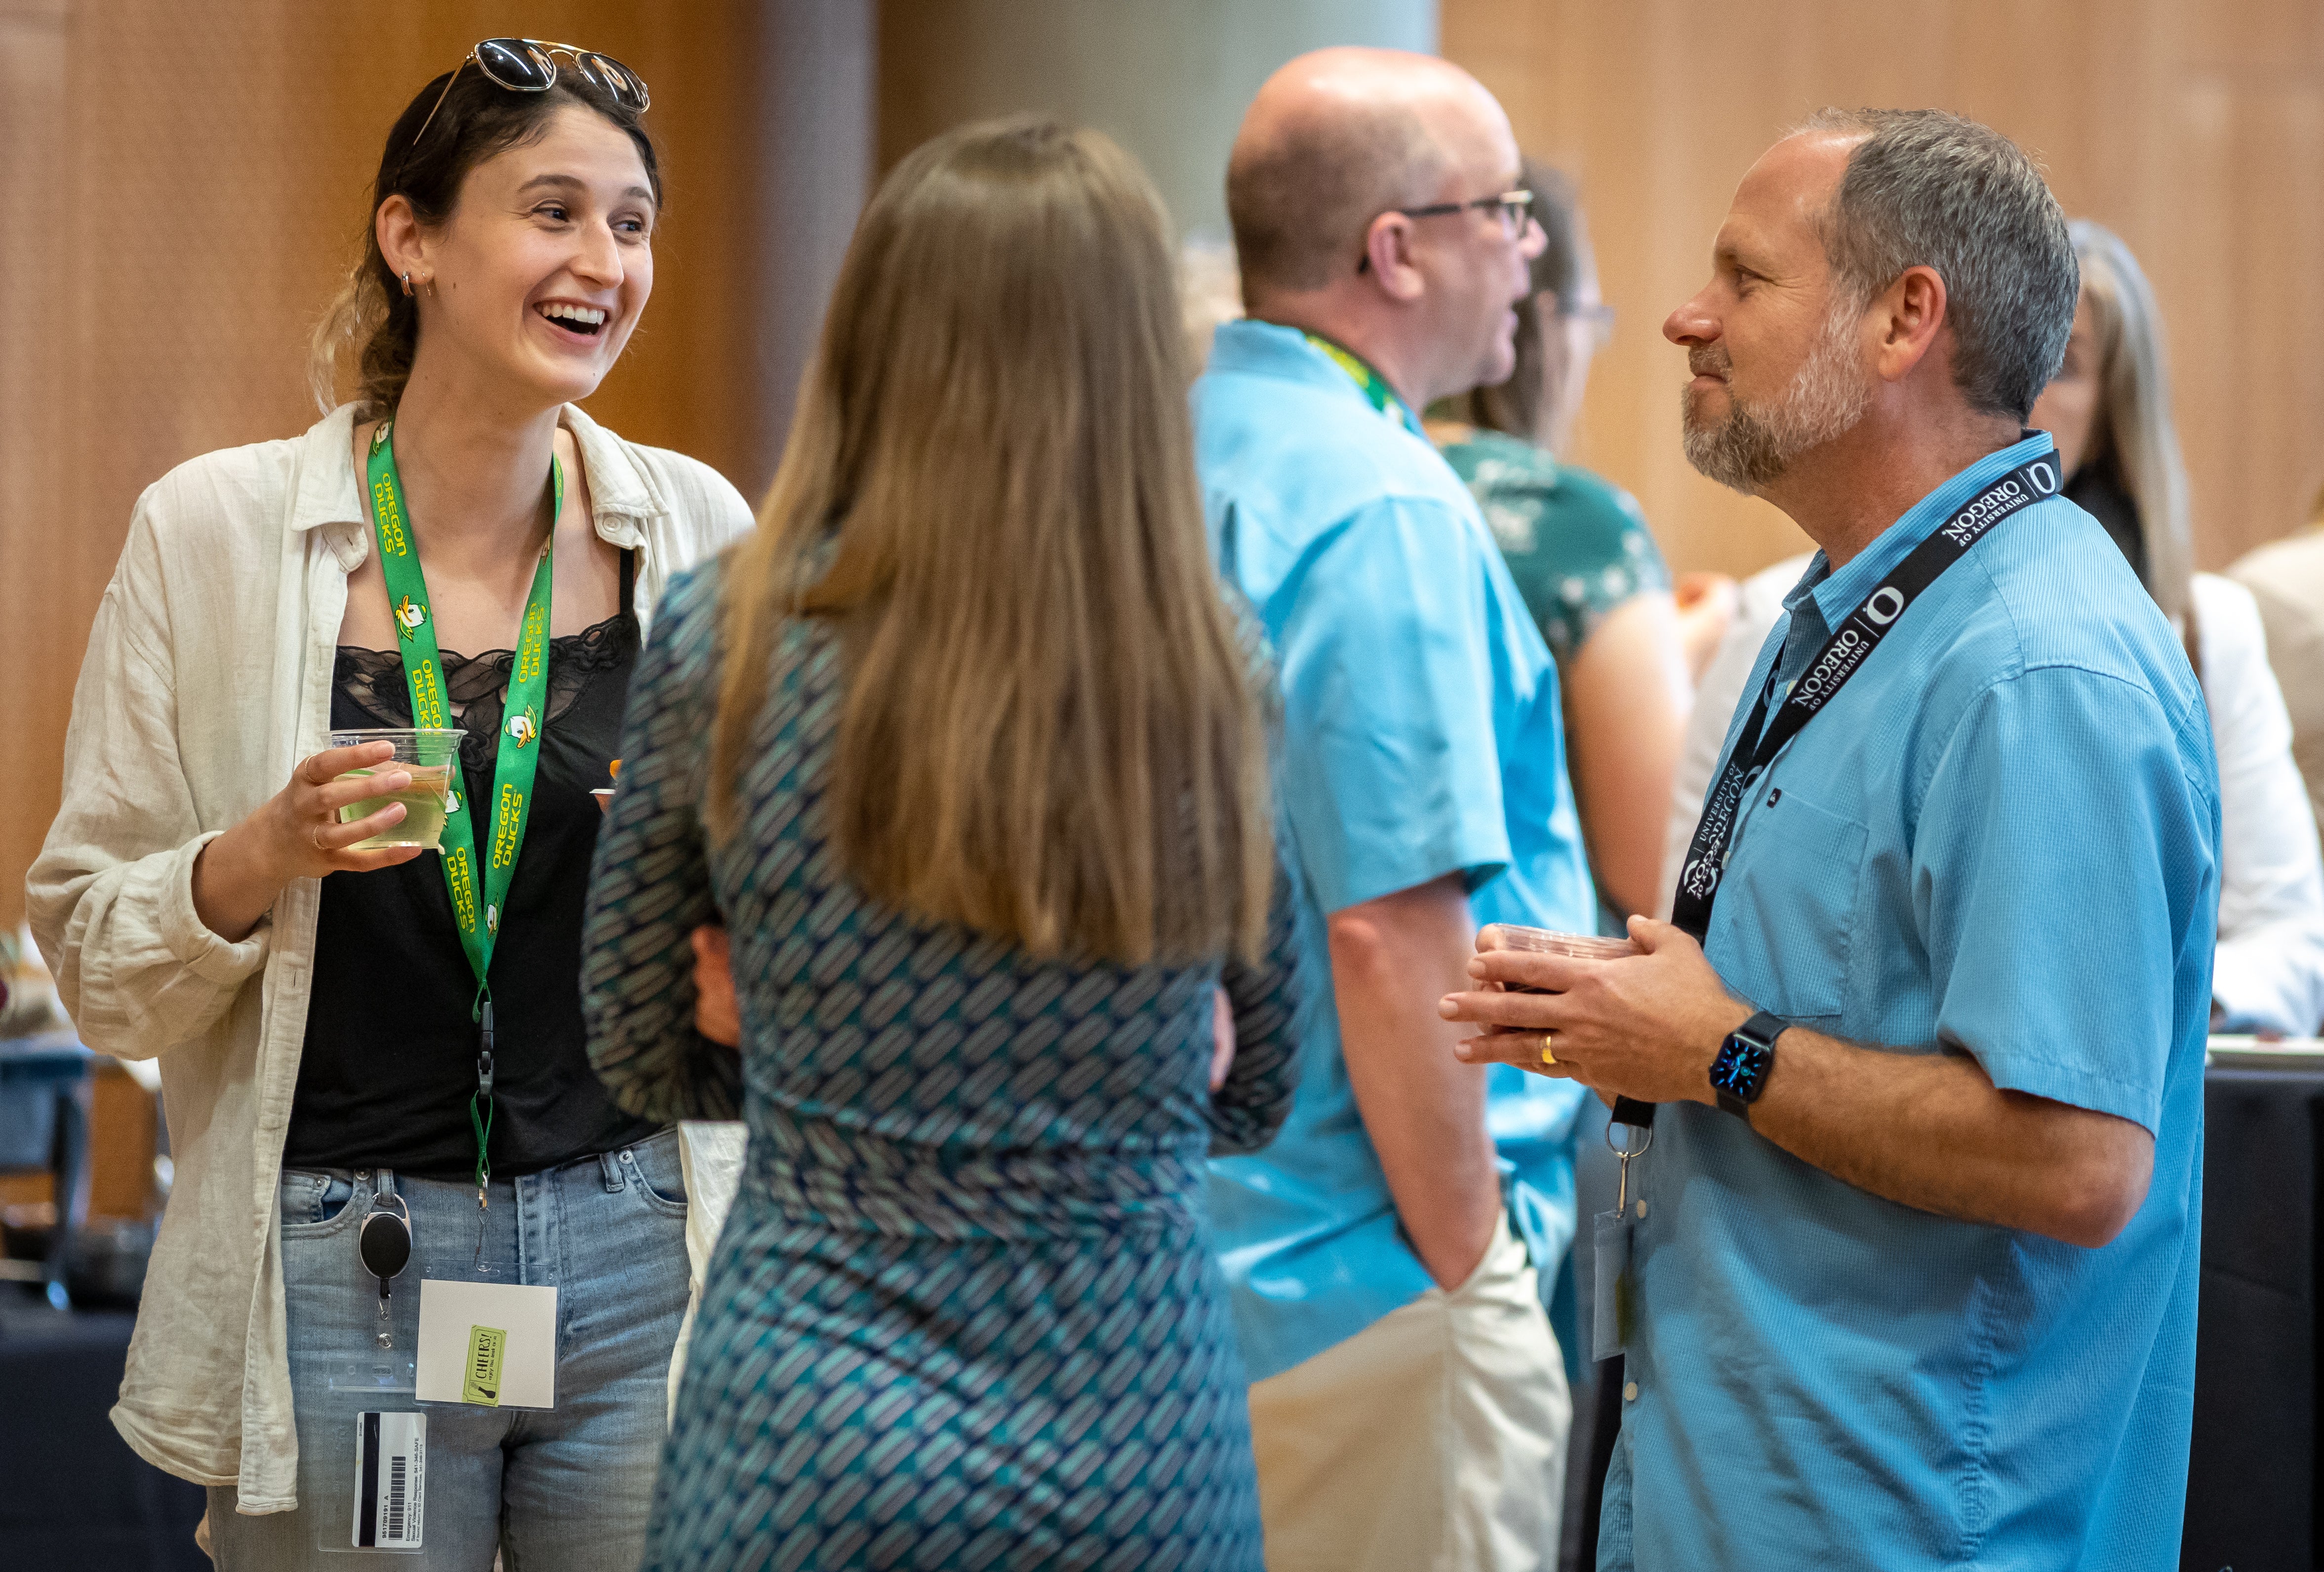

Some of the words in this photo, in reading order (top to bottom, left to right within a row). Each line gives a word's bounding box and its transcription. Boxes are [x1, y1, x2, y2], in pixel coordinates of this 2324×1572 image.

[374, 482, 395, 553] DUCKS
[382, 472, 407, 556] OREGON
[1943, 480, 2020, 541] OREGON
[1959, 533, 1972, 547] OF
[1972, 494, 2029, 534] UNIVERSITY
[519, 603, 537, 683] OREGON
[530, 607, 544, 676] DUCKS
[1792, 629, 1859, 707] OREGON
[1820, 641, 1870, 698] UNIVERSITY
[1809, 698, 1822, 710] OF
[493, 783, 513, 869] OREGON
[502, 792, 522, 866] DUCKS
[1699, 777, 1730, 841] UNIVERSITY
[446, 856, 468, 930] DUCKS
[456, 847, 475, 933] OREGON
[475, 1333, 492, 1379] CHEERS!
